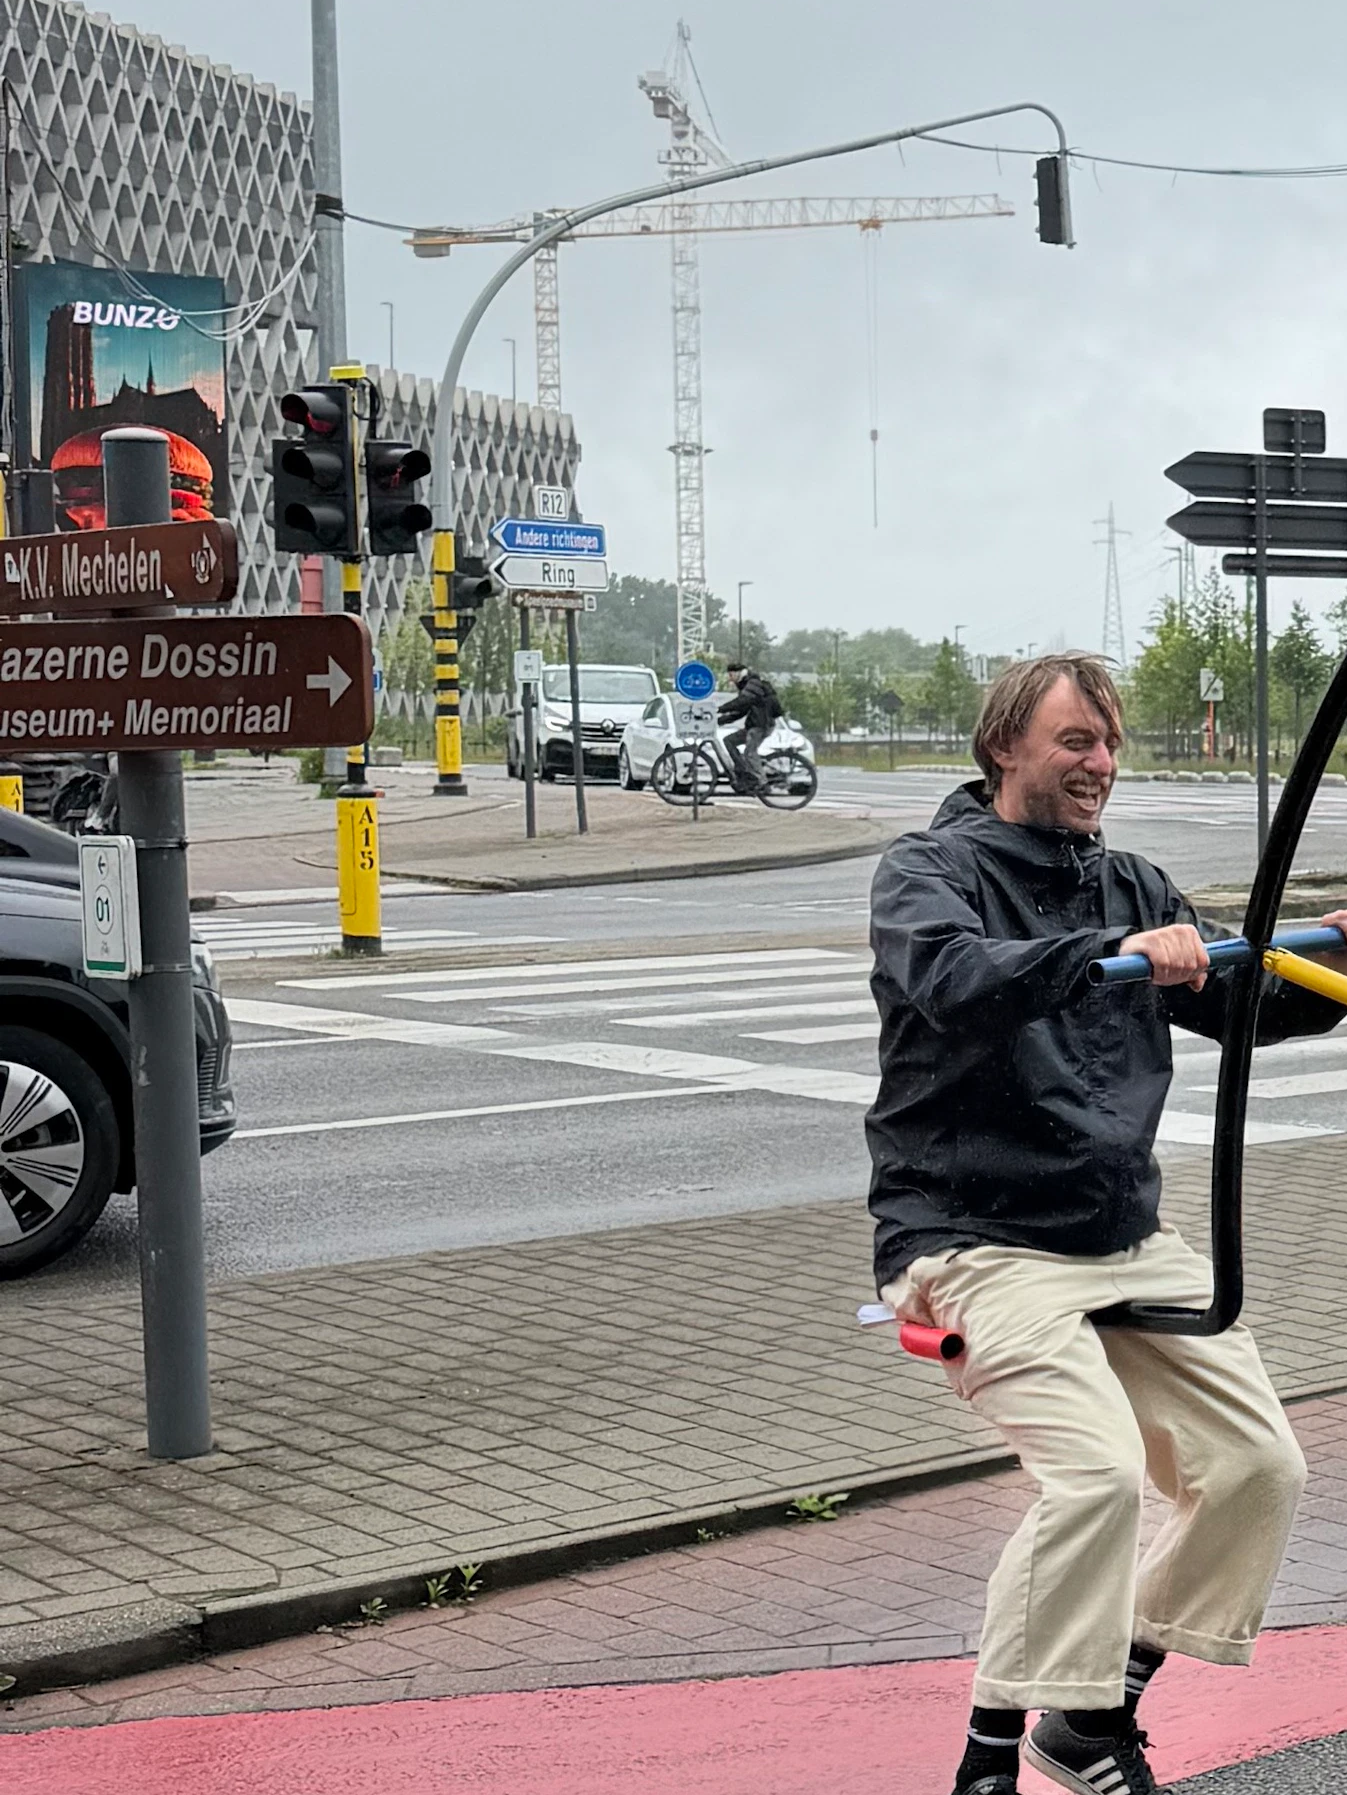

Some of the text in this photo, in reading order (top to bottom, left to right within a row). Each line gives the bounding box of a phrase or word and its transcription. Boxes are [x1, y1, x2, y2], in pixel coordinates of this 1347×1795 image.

[542, 493, 563, 515] R12
[515, 526, 598, 551] Andere richtingen
[19, 537, 162, 600] K.V. Mechelen
[542, 562, 575, 588] Ring
[0, 632, 278, 682] azerne Dossin
[124, 696, 293, 735] Memoriaal
[359, 805, 374, 870] A15
[96, 897, 110, 923] 01
